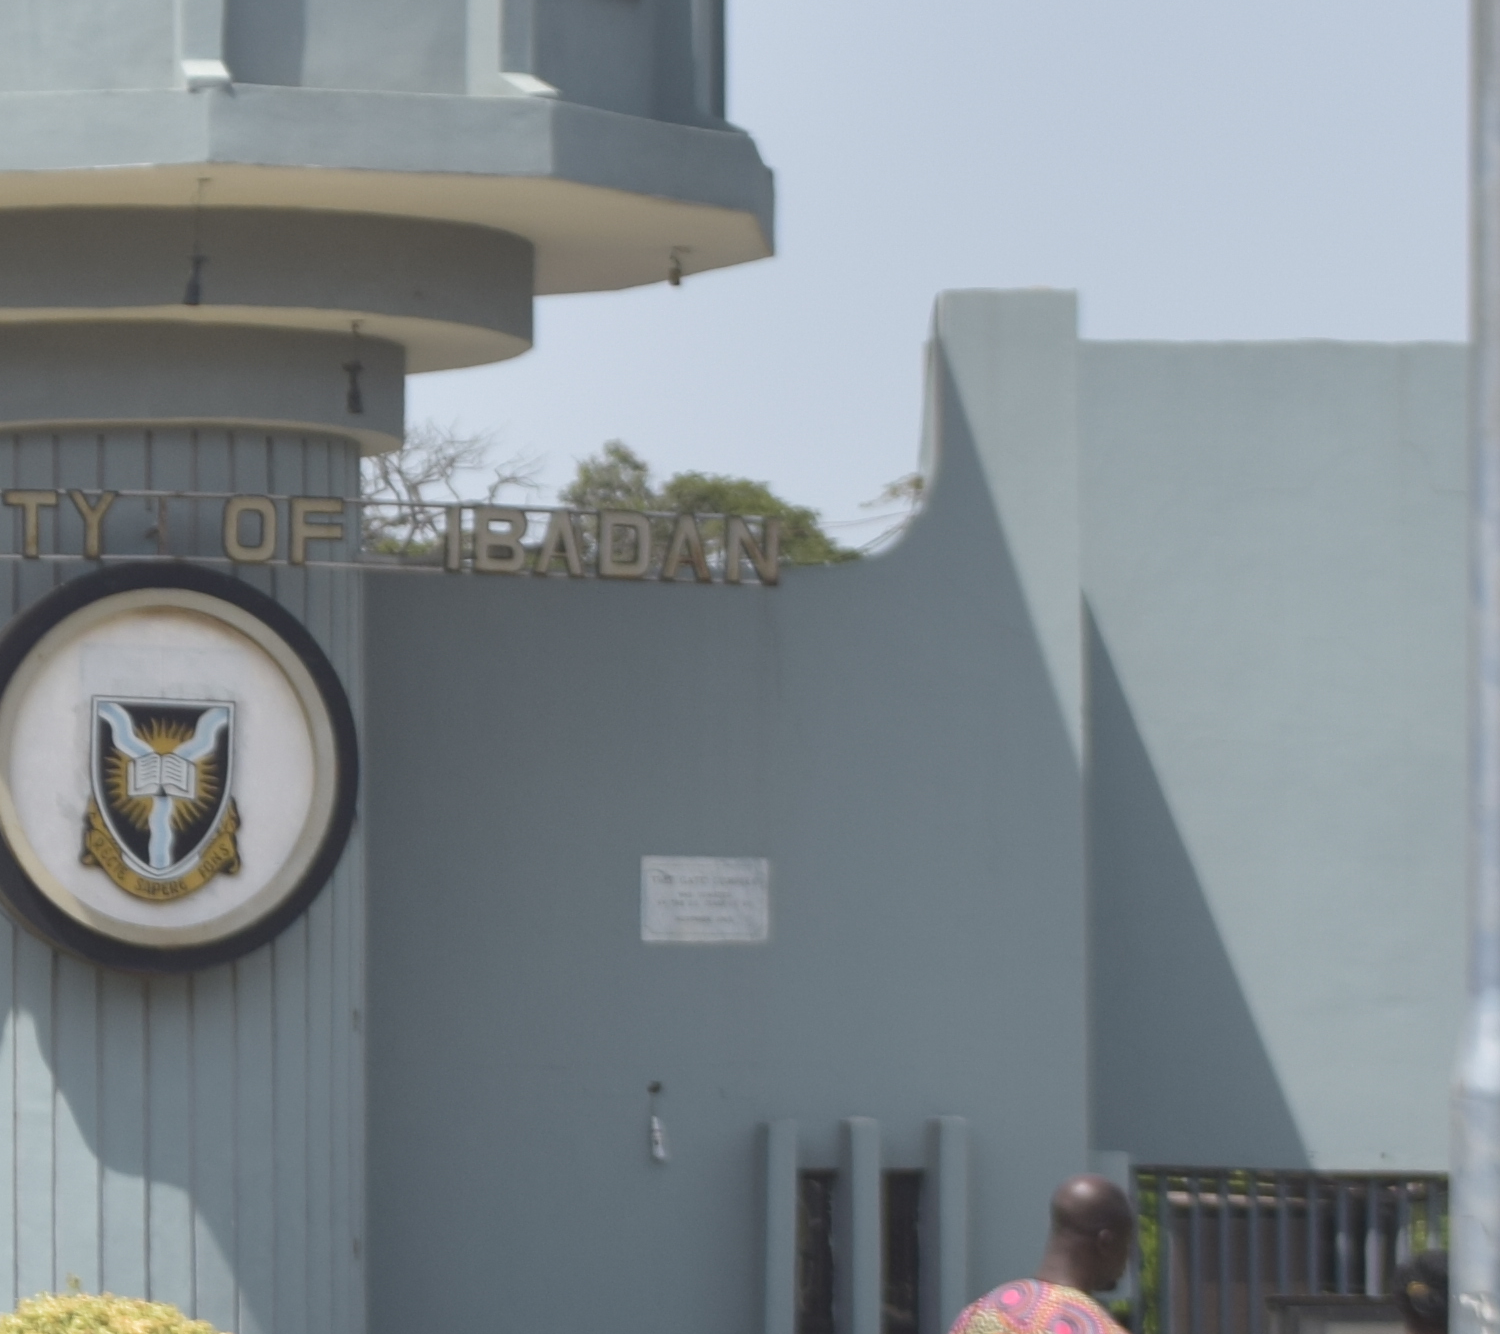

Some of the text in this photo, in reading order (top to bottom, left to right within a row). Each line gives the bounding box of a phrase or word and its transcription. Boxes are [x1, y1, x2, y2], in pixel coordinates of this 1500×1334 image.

[222, 494, 344, 565] OF
[443, 505, 780, 586] IBADAN
[135, 879, 188, 895] SAPERE
